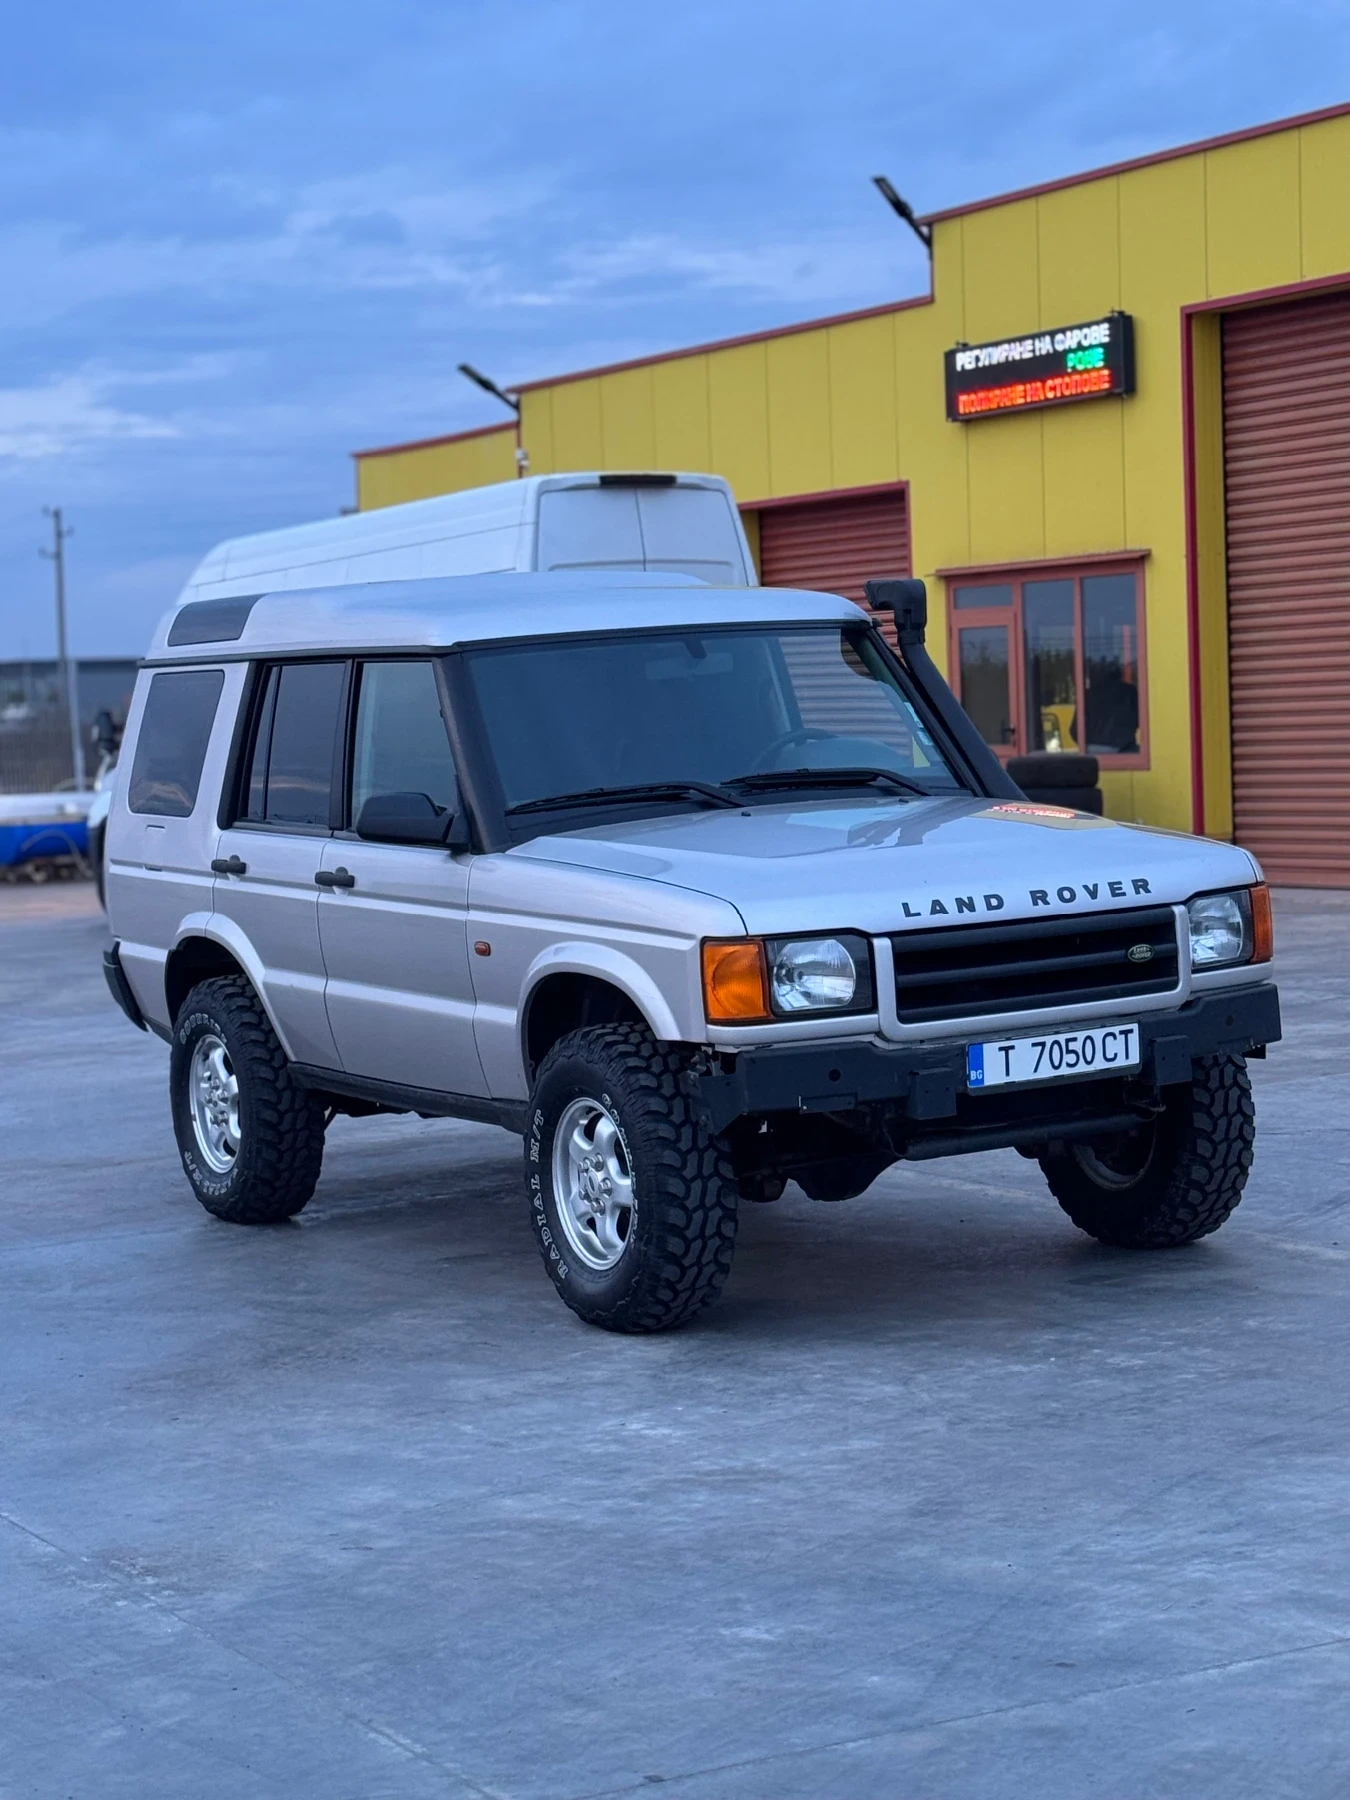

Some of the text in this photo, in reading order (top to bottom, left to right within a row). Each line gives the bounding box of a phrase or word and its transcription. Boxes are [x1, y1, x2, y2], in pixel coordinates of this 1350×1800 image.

[955, 323, 1111, 372] РЕГУЛИРАНЕ НА ФАРОВЕ
[1025, 381, 1045, 403] НА
[1045, 369, 1111, 399] СТОПОВЕ
[901, 878, 1152, 918] LAND ROVER
[970, 1069, 983, 1081] BG
[998, 1045, 1016, 1077] T
[529, 1108, 570, 1280] RADIAL M/T
